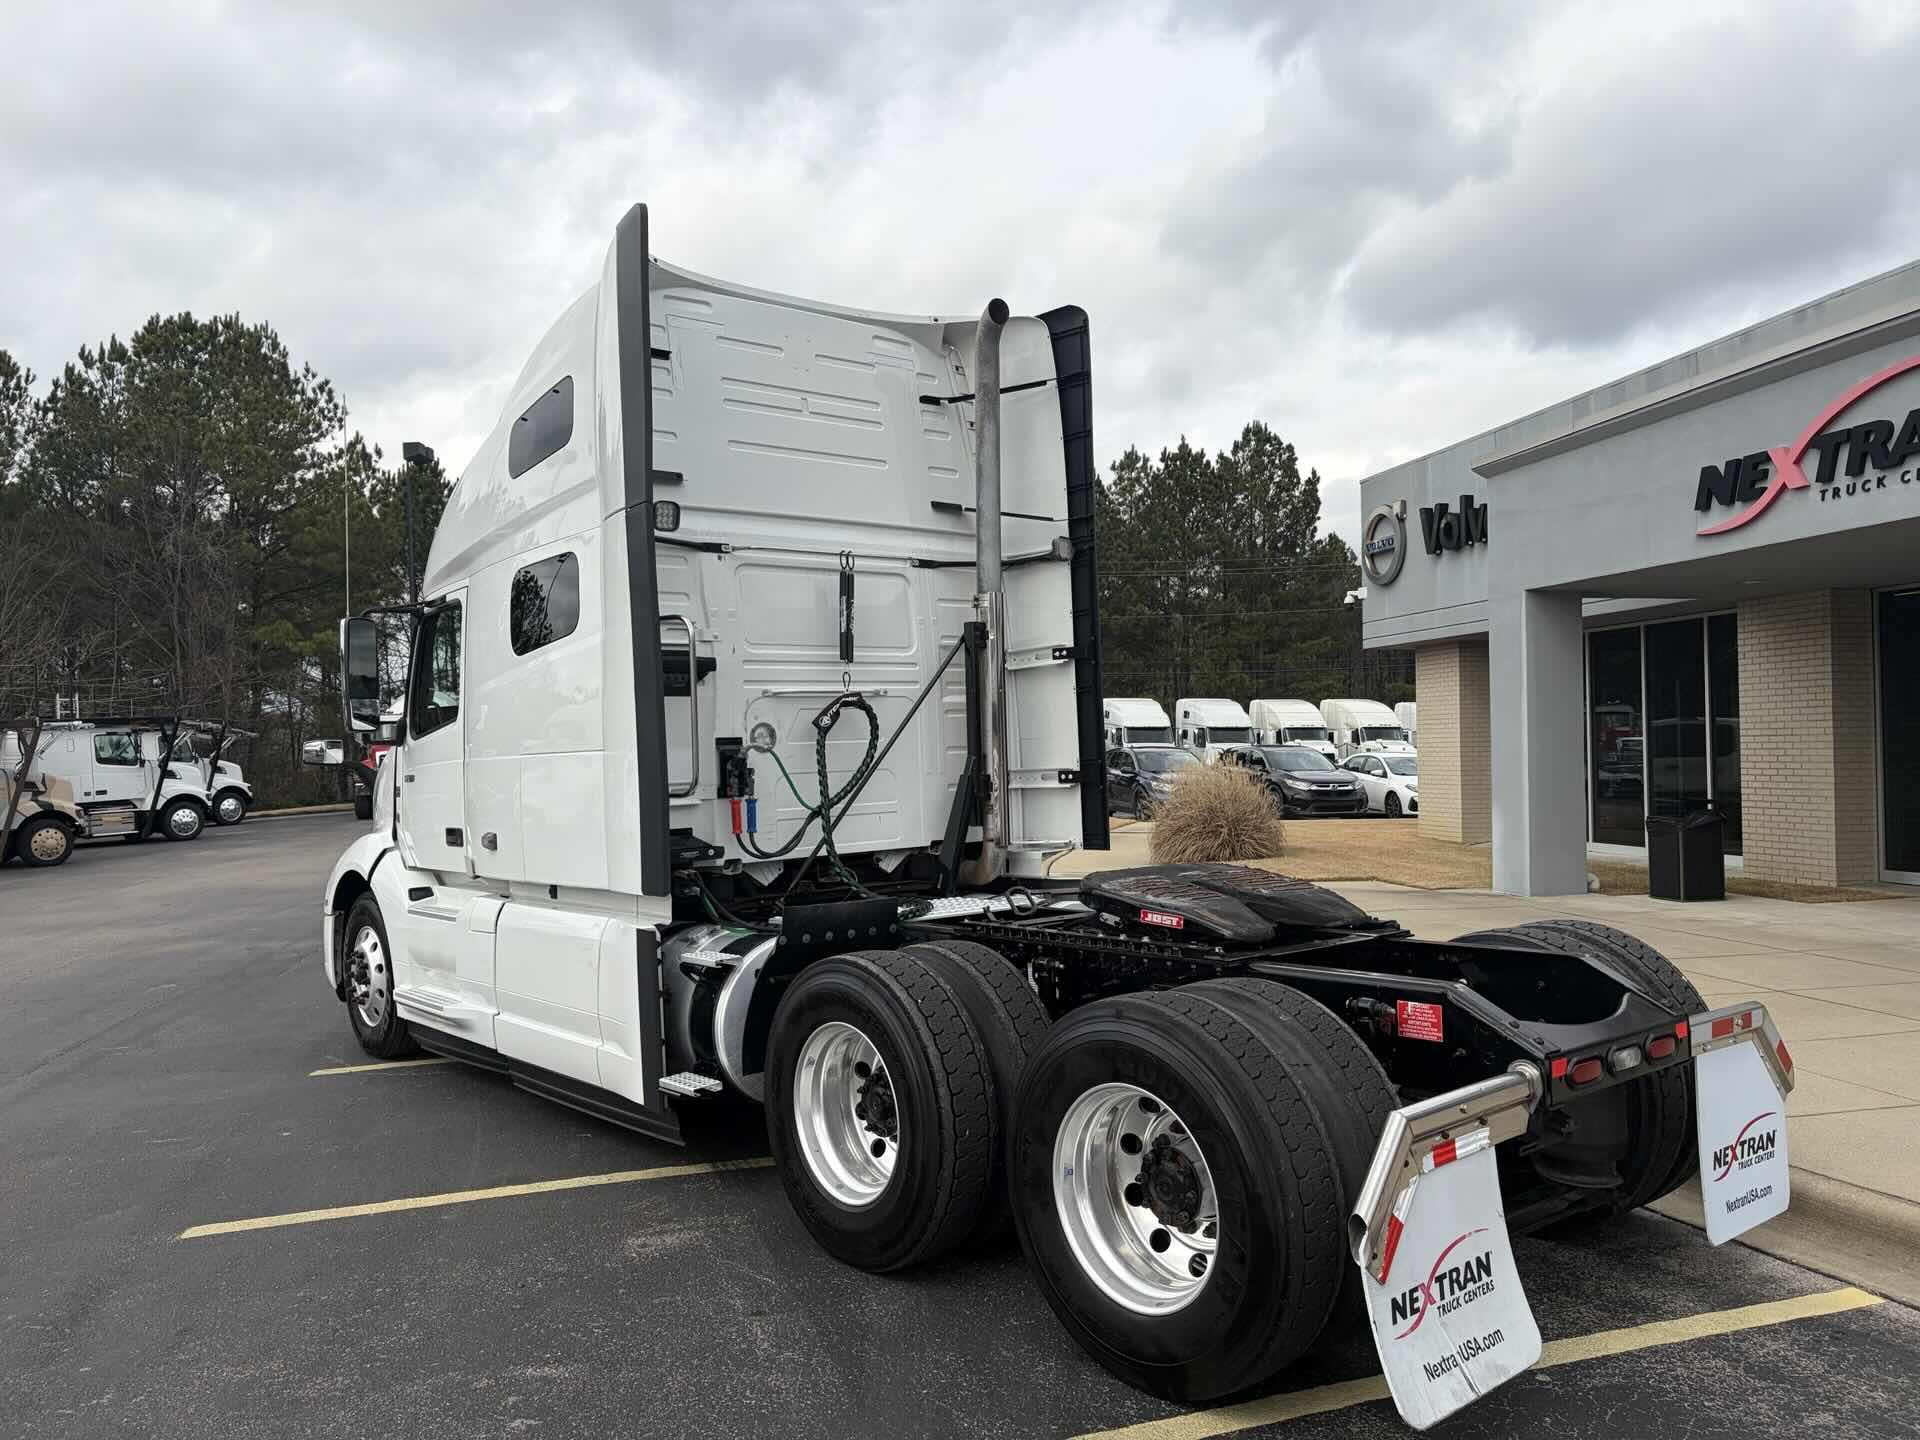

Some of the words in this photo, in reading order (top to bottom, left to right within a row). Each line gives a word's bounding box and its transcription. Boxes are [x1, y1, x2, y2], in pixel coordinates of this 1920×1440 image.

[1819, 474, 1887, 502] TRUCK
[1366, 536, 1396, 553] VOLVO
[1145, 912, 1177, 926] JOST
[1713, 1129, 1776, 1171] NEXTRAN
[1738, 1157, 1753, 1171] TRUCK
[1754, 1150, 1775, 1164] CENTERS
[1725, 1184, 1773, 1214] NextranUSA.com
[1391, 1251, 1492, 1326] NEXTRAN
[1436, 1299, 1462, 1318] TRUCK
[1463, 1279, 1495, 1304] CENTERS
